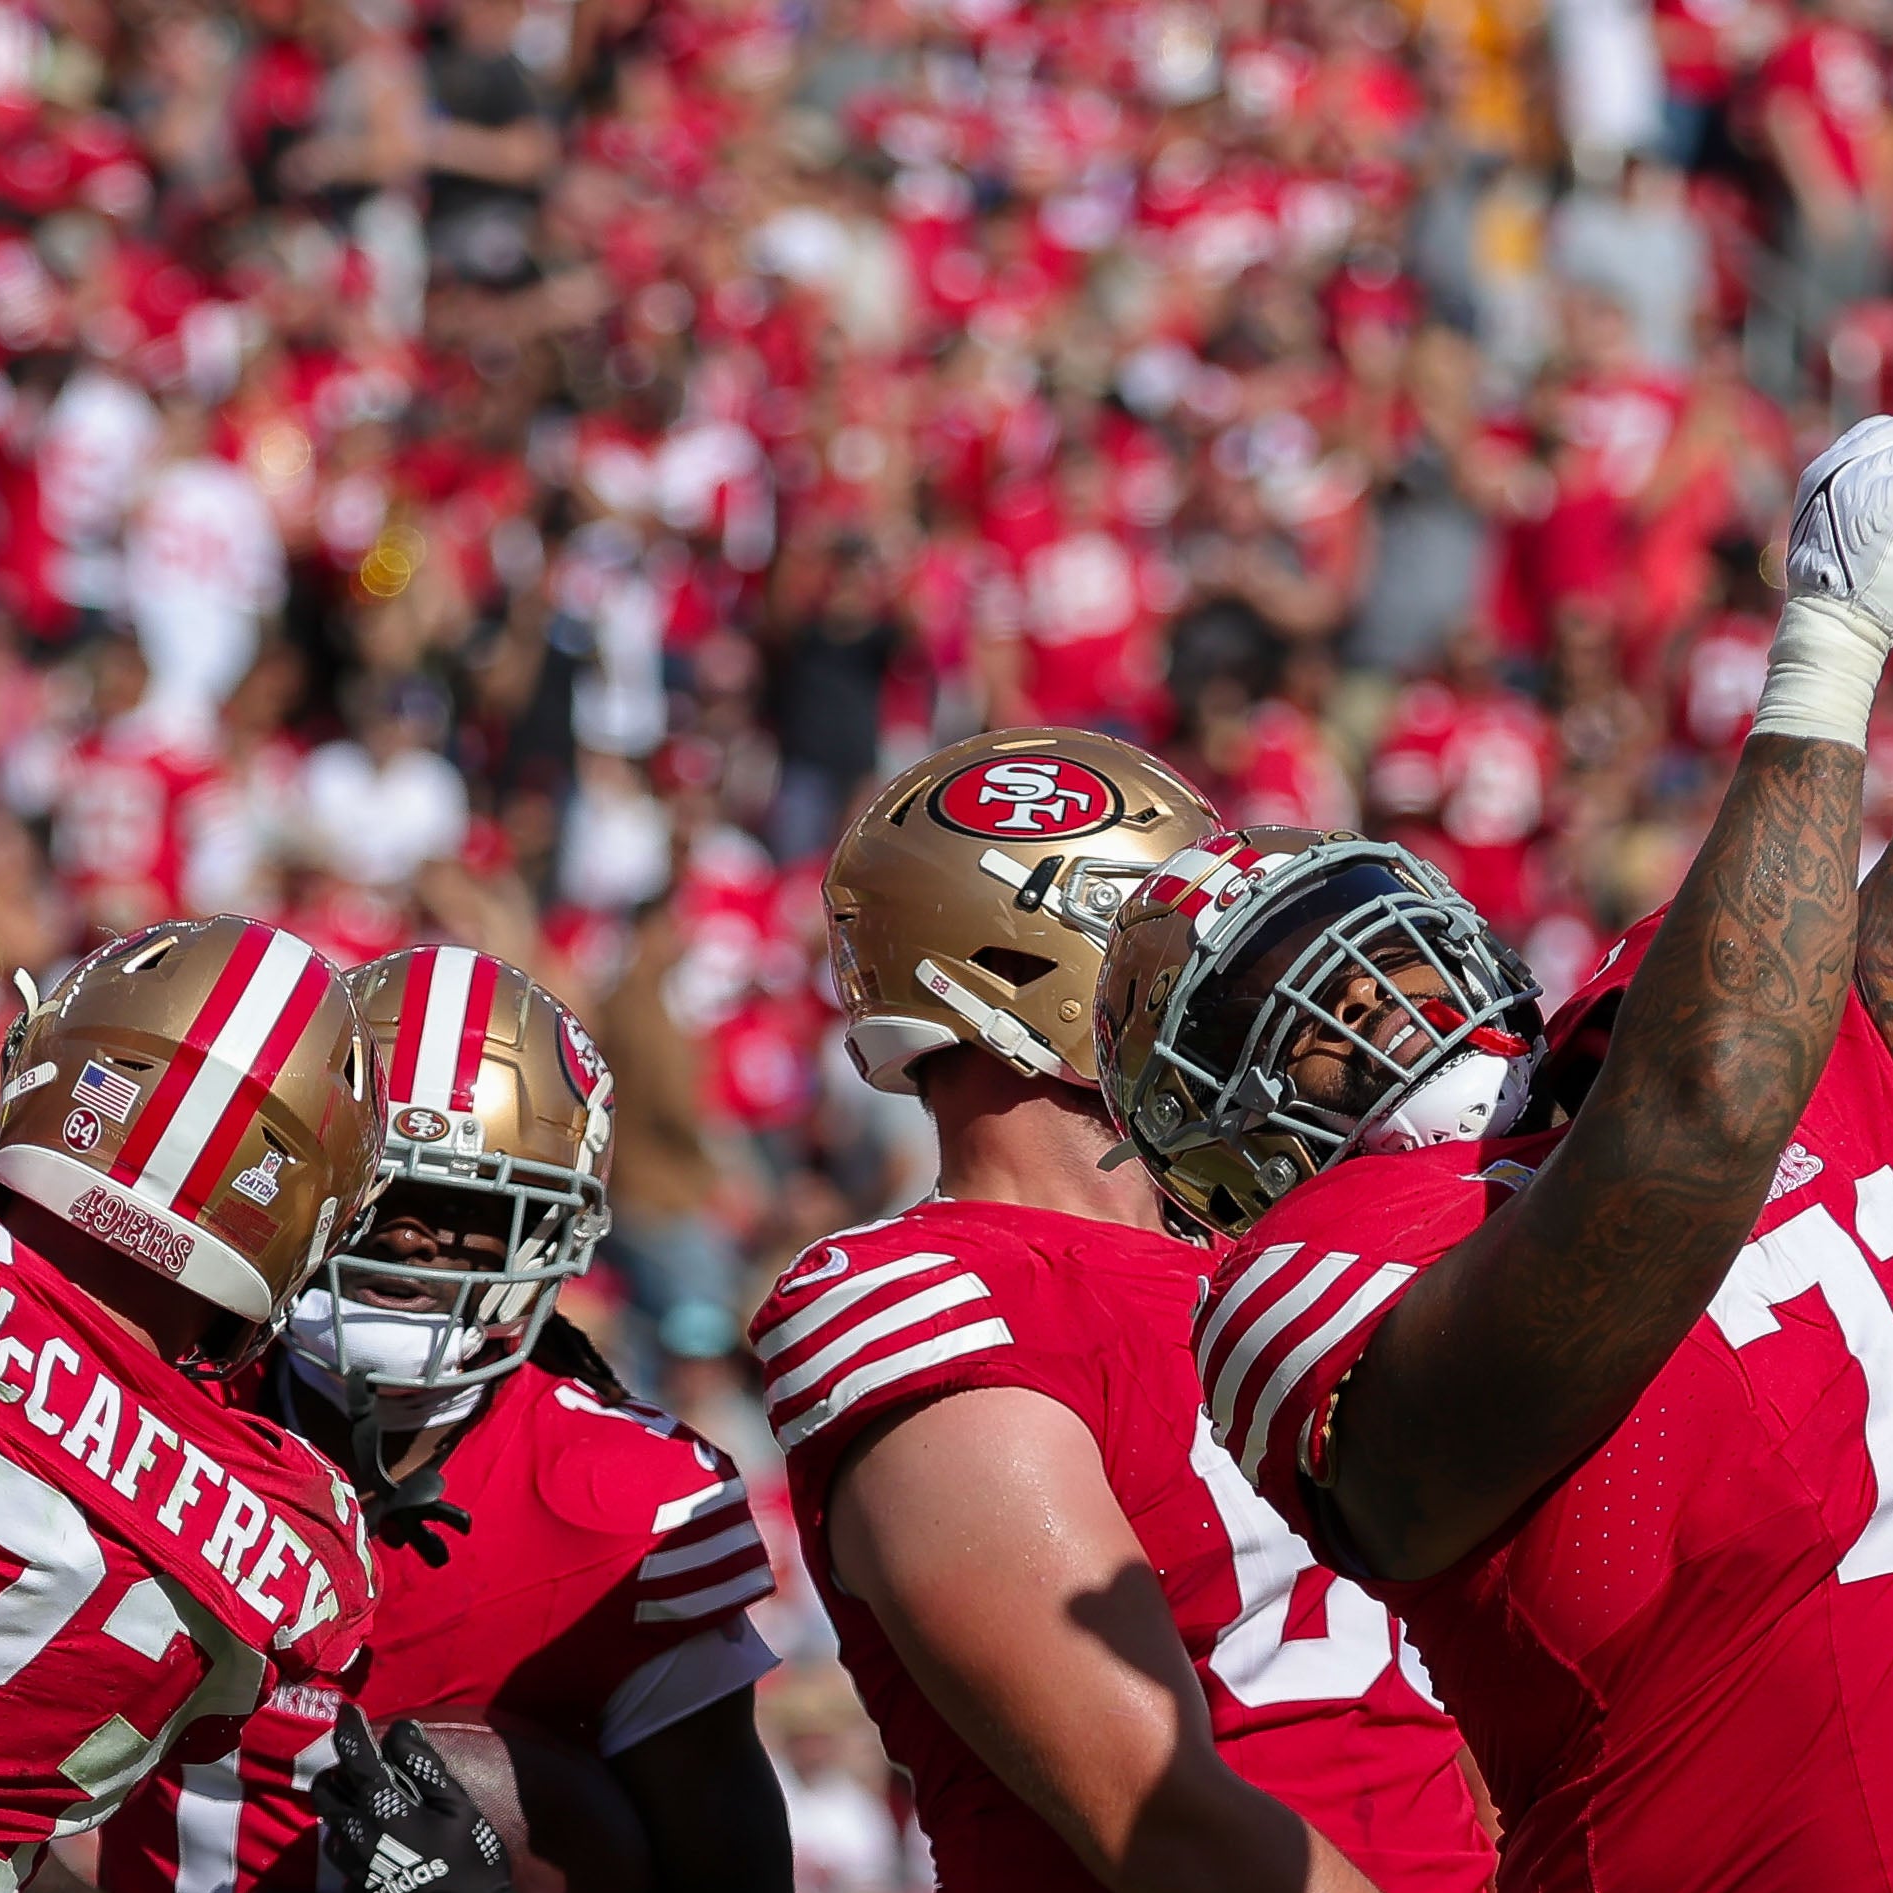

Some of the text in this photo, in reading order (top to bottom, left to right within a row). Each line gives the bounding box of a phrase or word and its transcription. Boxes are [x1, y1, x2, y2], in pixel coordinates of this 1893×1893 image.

[978, 762, 1090, 831] SF
[18, 1072, 36, 1089] 23
[67, 1115, 96, 1148] 64
[238, 1173, 276, 1198] CATCH
[71, 1185, 195, 1276] 49ERS
